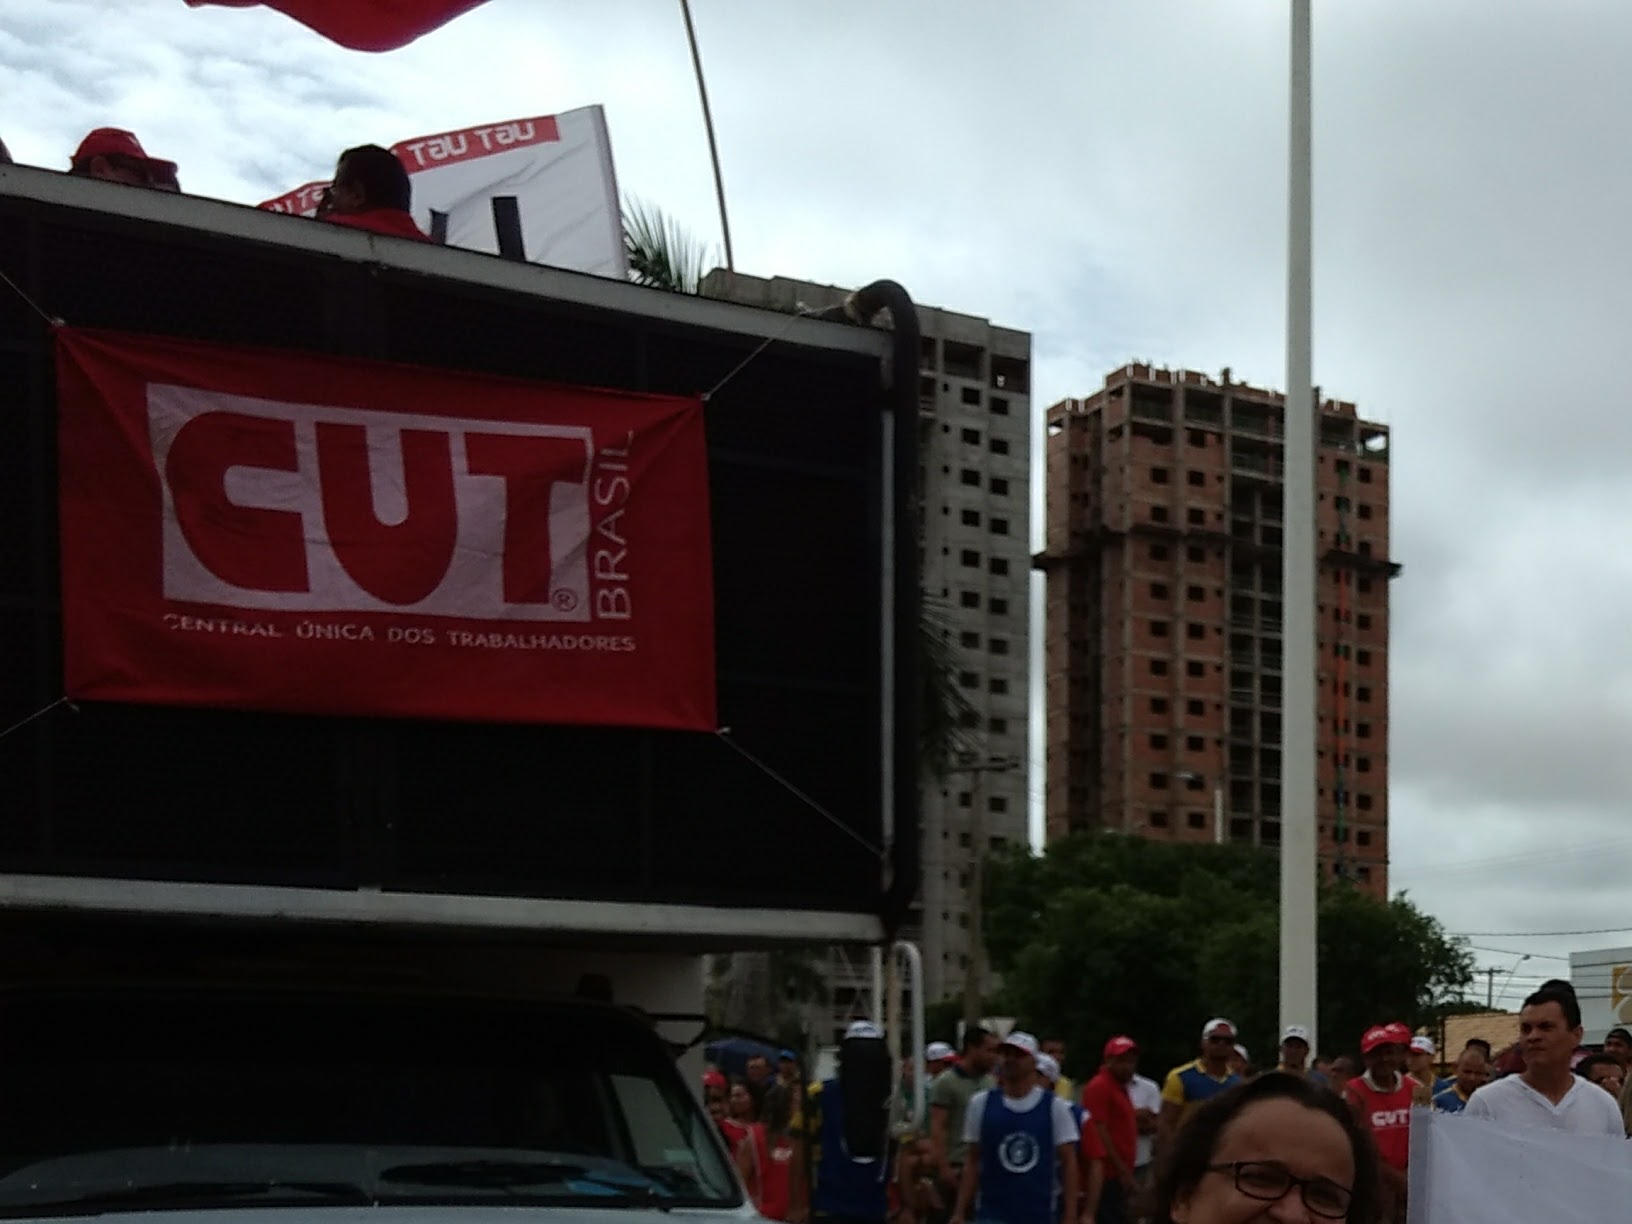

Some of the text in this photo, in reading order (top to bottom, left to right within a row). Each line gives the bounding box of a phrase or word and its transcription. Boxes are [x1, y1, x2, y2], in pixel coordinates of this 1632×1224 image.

[165, 410, 588, 605] CUT
[594, 429, 635, 620] BRASIL
[162, 613, 636, 653] CENTRAL ÚNICA DOS TRABALHADORES
